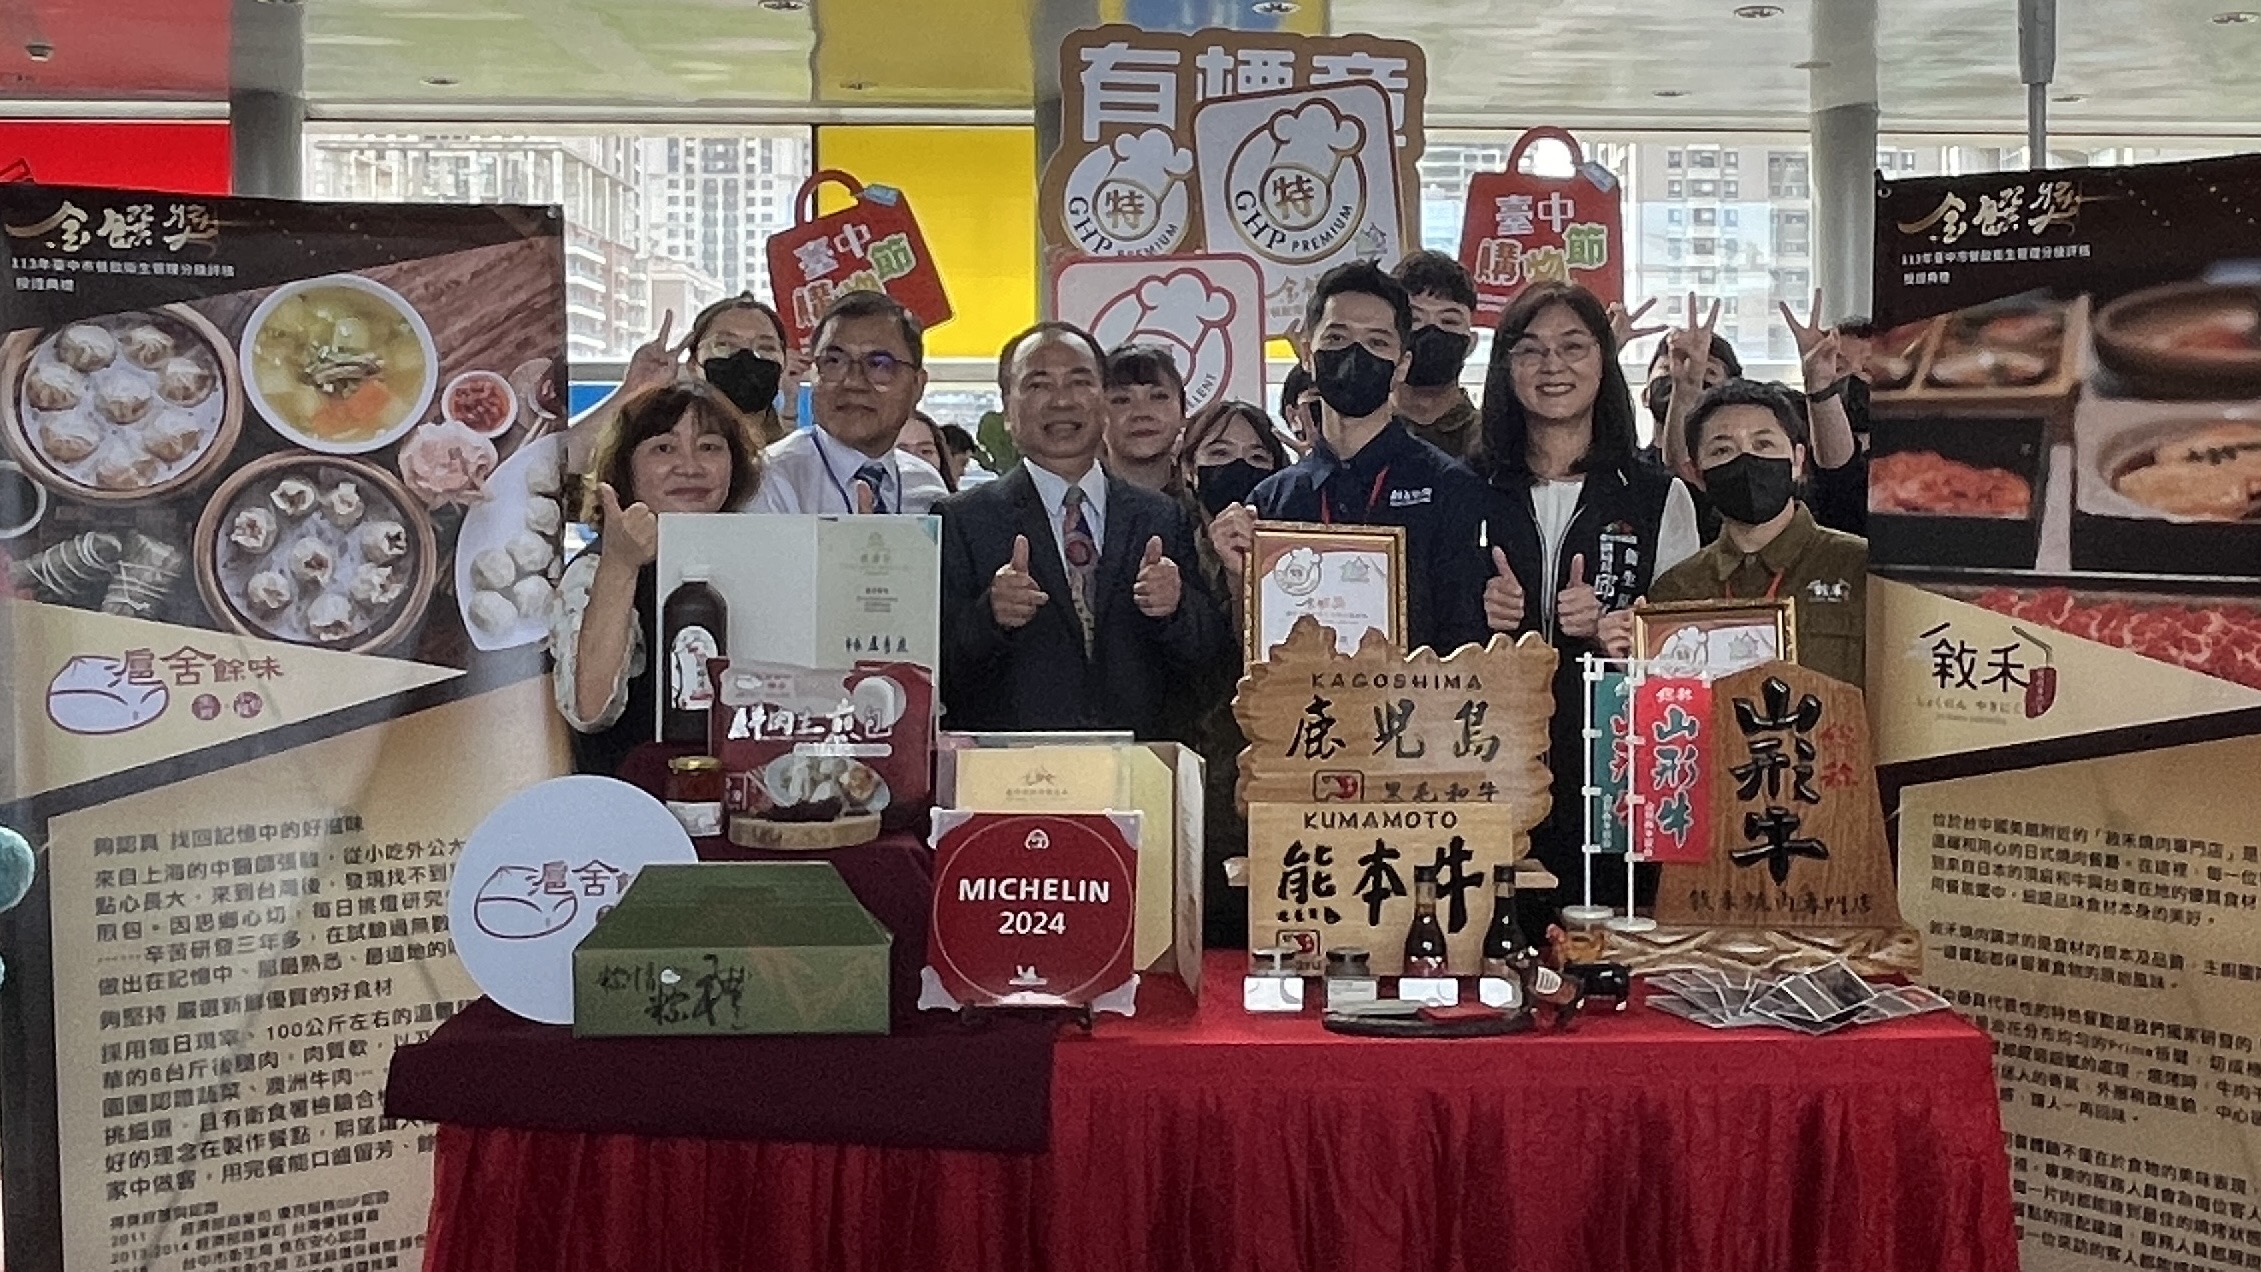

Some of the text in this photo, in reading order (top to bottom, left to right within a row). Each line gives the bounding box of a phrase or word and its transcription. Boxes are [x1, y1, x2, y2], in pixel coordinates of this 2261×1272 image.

[1105, 189, 1144, 229] 特
[1235, 190, 1286, 249] GHP
[1272, 174, 1314, 220] 特
[1496, 192, 1574, 235] 臺中
[1068, 196, 1113, 254] GHP
[1291, 204, 1352, 252] PREMIUM
[793, 223, 871, 281] 臺中
[104, 646, 284, 688] 滬舍餘味
[1312, 673, 1482, 690] KAGOSHIMA
[1931, 638, 2030, 692] 敘禾
[1651, 704, 1699, 848] 山形牛
[1729, 676, 1829, 886] 山形牛
[1304, 810, 1458, 829] KUMAMOTO
[959, 878, 1109, 902] MICHELIN
[1277, 835, 1484, 935] 熊本牛
[998, 912, 1066, 935] 2024
